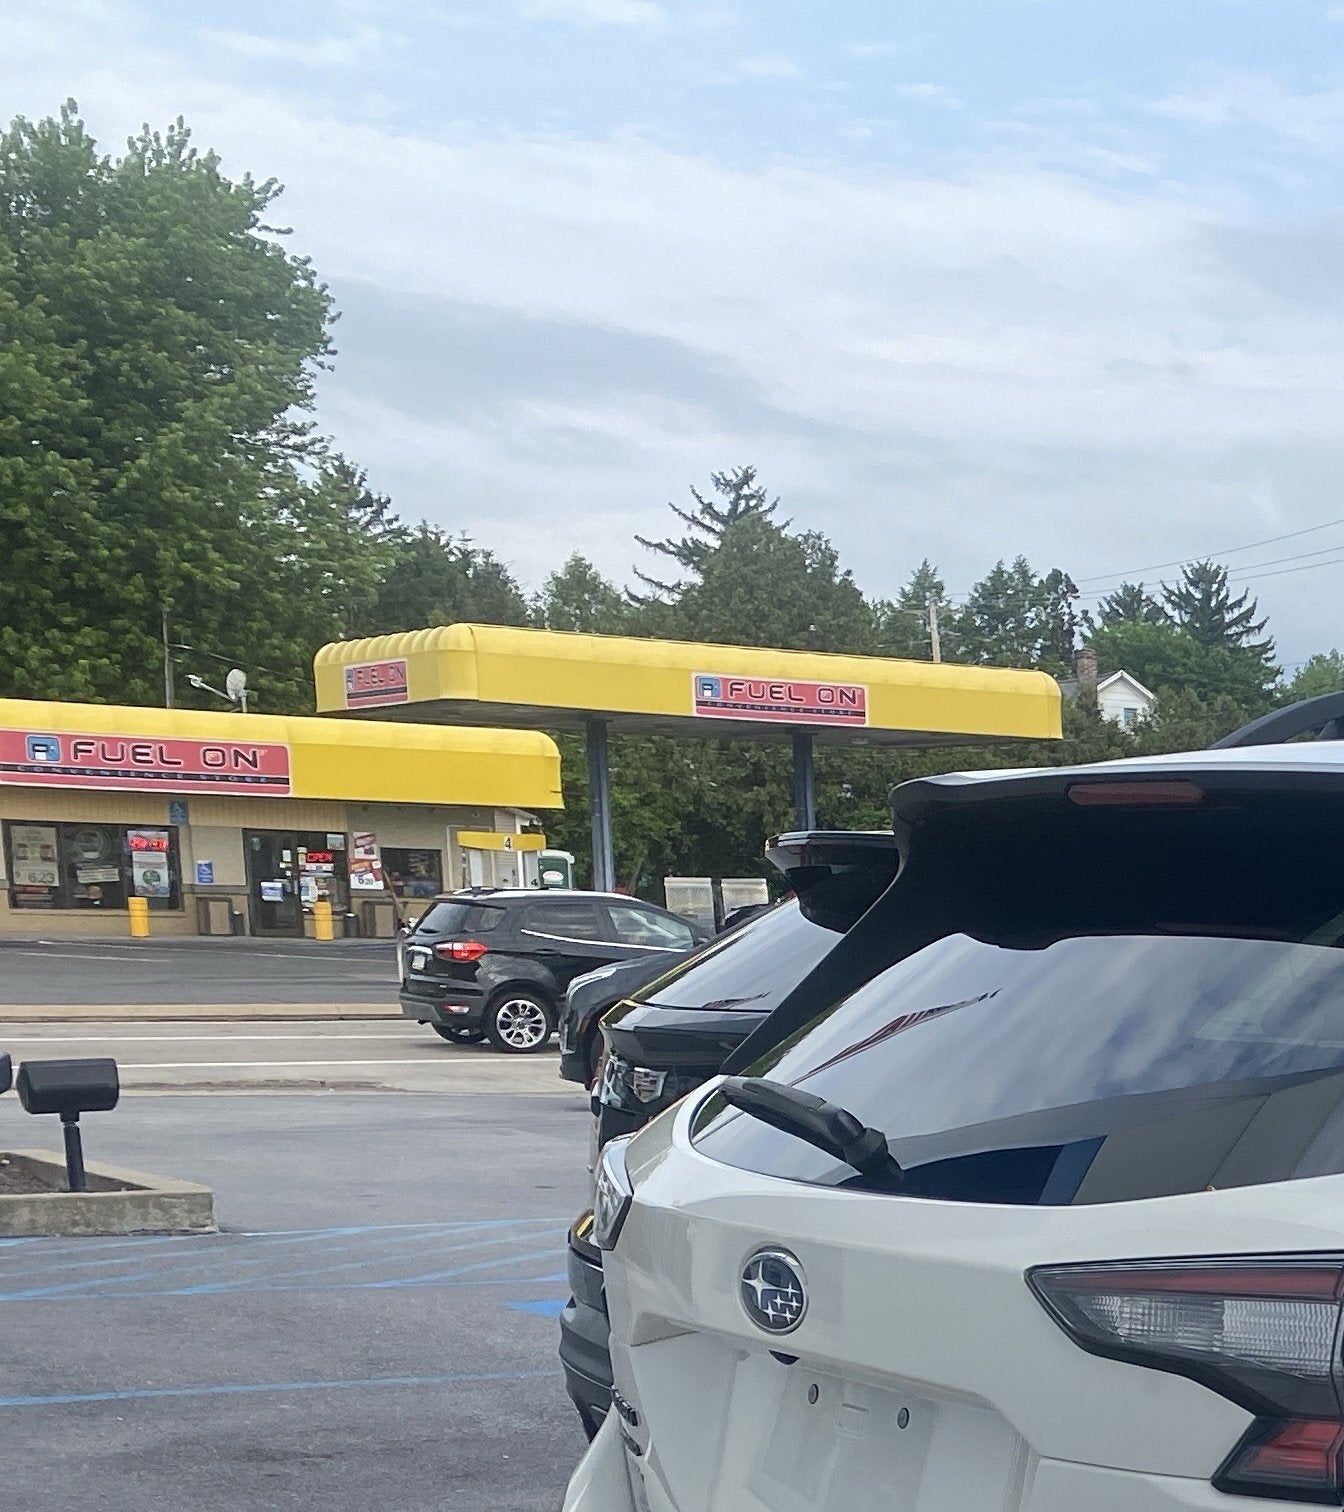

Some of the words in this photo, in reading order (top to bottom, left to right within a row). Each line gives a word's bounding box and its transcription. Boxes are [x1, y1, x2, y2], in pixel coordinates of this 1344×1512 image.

[728, 681, 805, 702] FUEL
[817, 687, 857, 705] ON
[73, 741, 182, 766] FUEL
[202, 747, 259, 769] ON
[504, 837, 512, 850] 4
